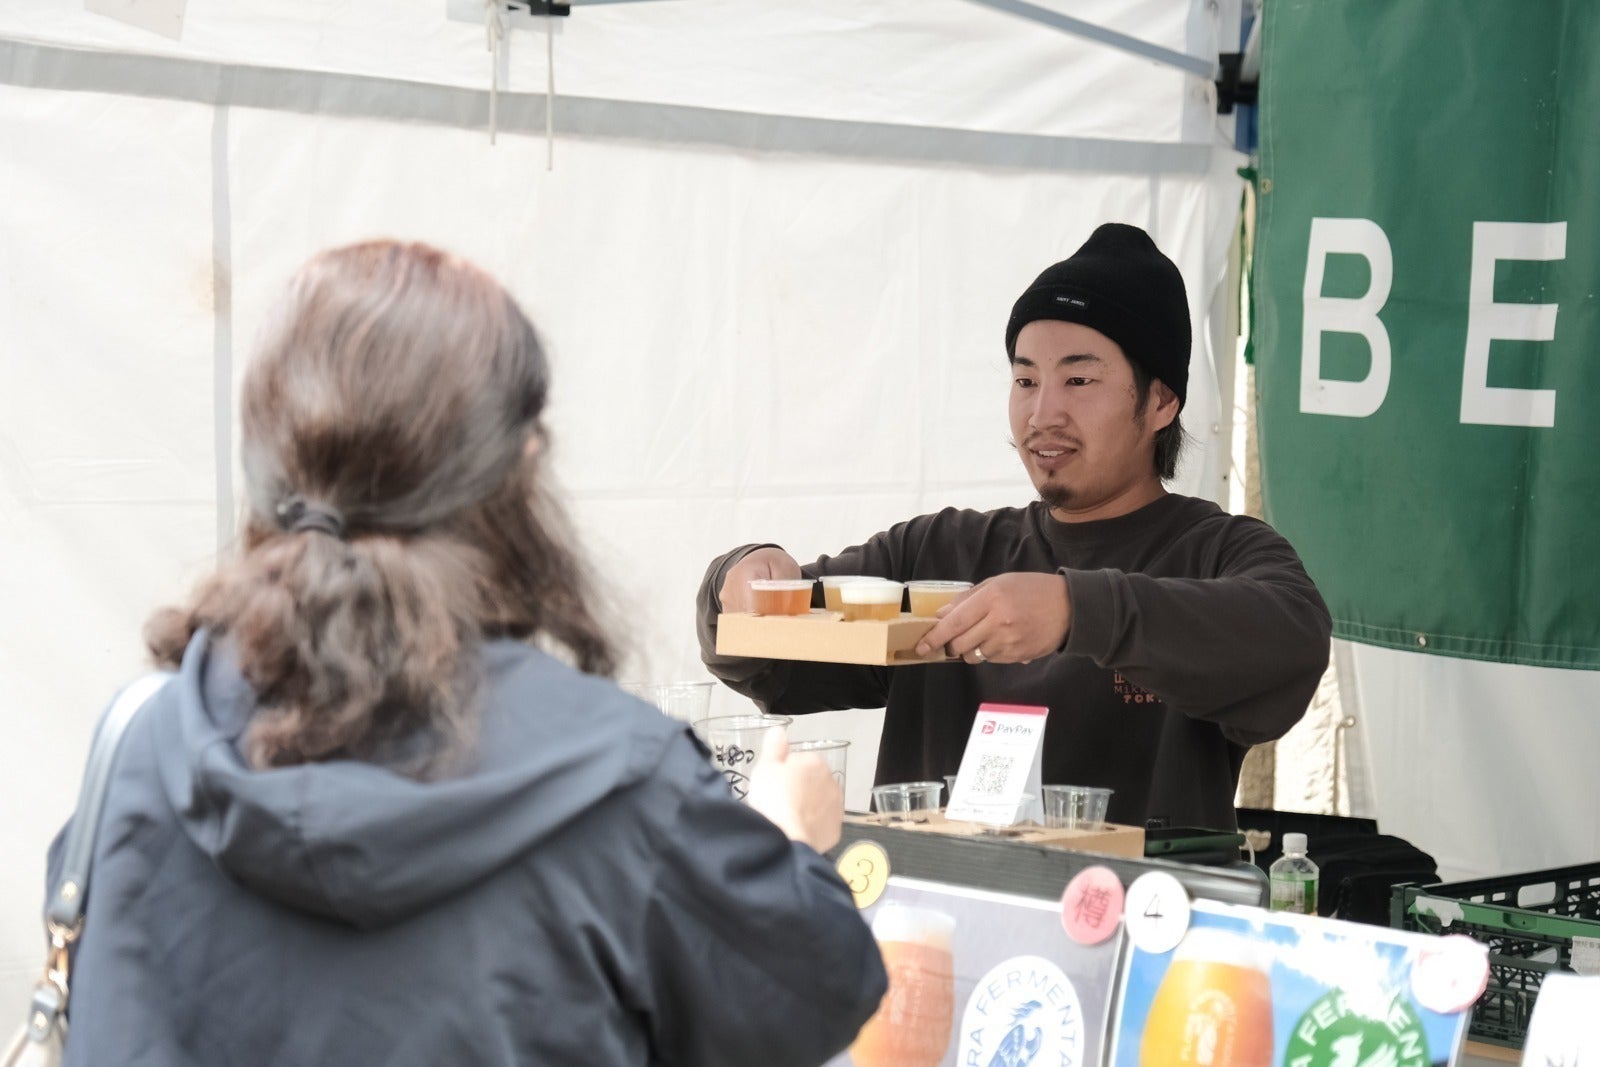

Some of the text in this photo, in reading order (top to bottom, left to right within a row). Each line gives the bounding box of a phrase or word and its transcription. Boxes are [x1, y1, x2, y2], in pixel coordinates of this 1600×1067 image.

[1123, 693, 1162, 704] TOK
[997, 723, 1032, 736] PayPay
[848, 859, 874, 894] 3
[1143, 893, 1164, 928] 4
